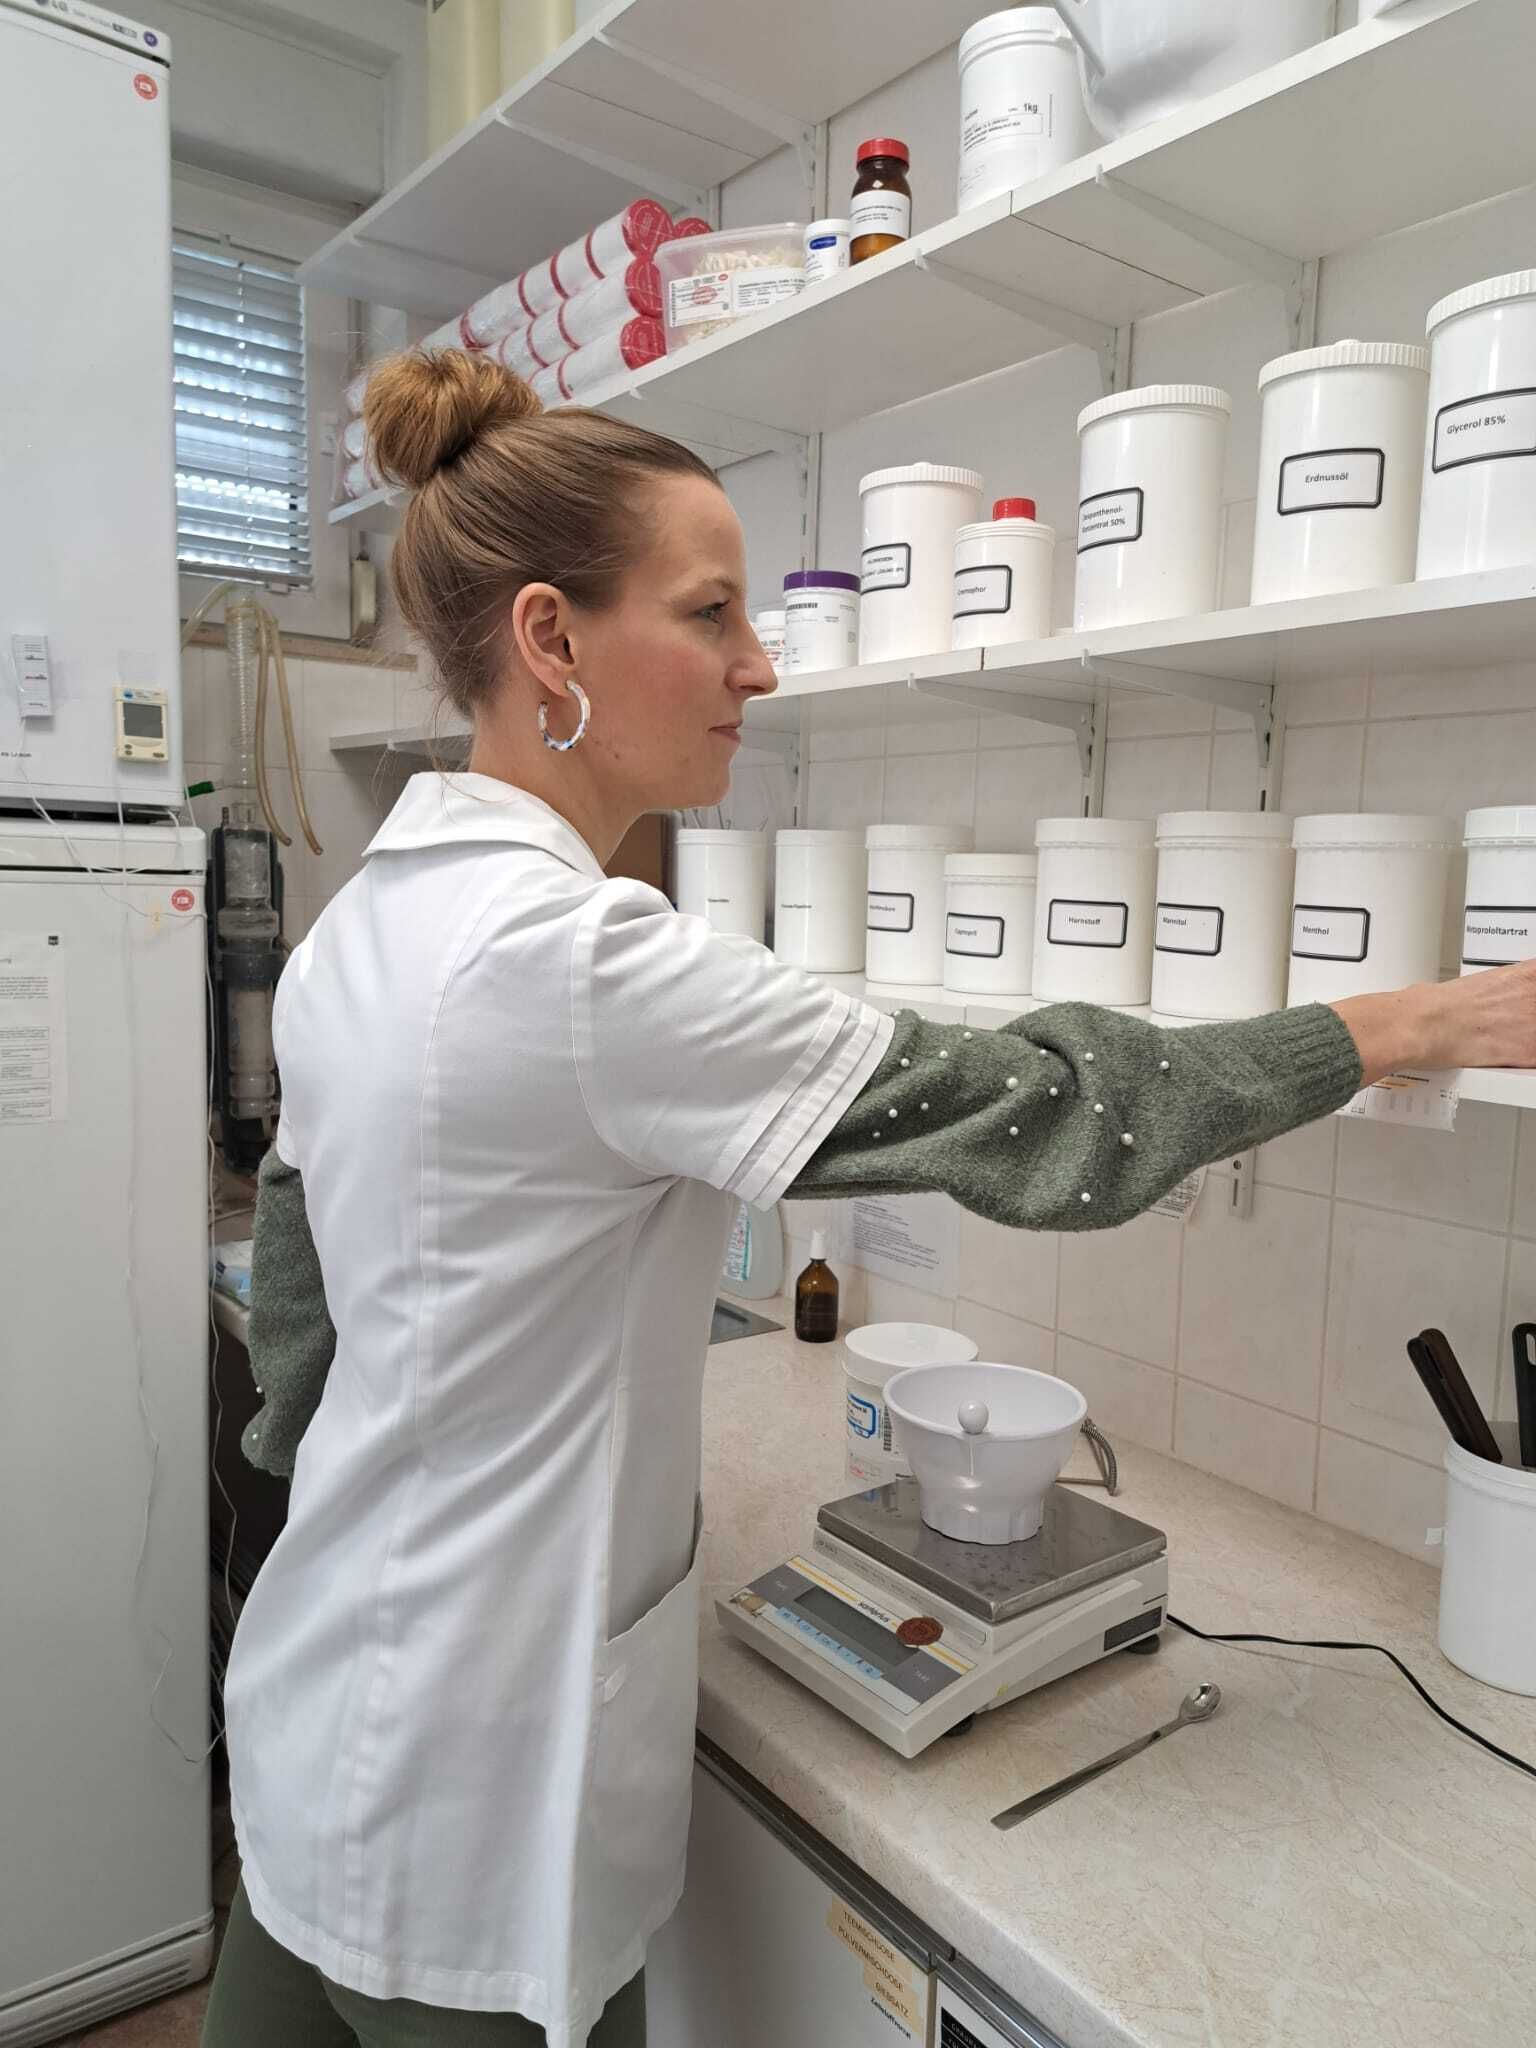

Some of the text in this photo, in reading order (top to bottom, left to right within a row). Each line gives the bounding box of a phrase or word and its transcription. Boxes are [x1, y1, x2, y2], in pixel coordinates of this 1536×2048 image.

[1023, 103, 1038, 114] 1kg
[1446, 415, 1507, 434] Glycerol 85%
[1304, 472, 1349, 483] Erdnussöl
[1110, 518, 1126, 527] 50%
[1068, 913, 1101, 926] Harnstoff
[1302, 925, 1330, 936] Menthol
